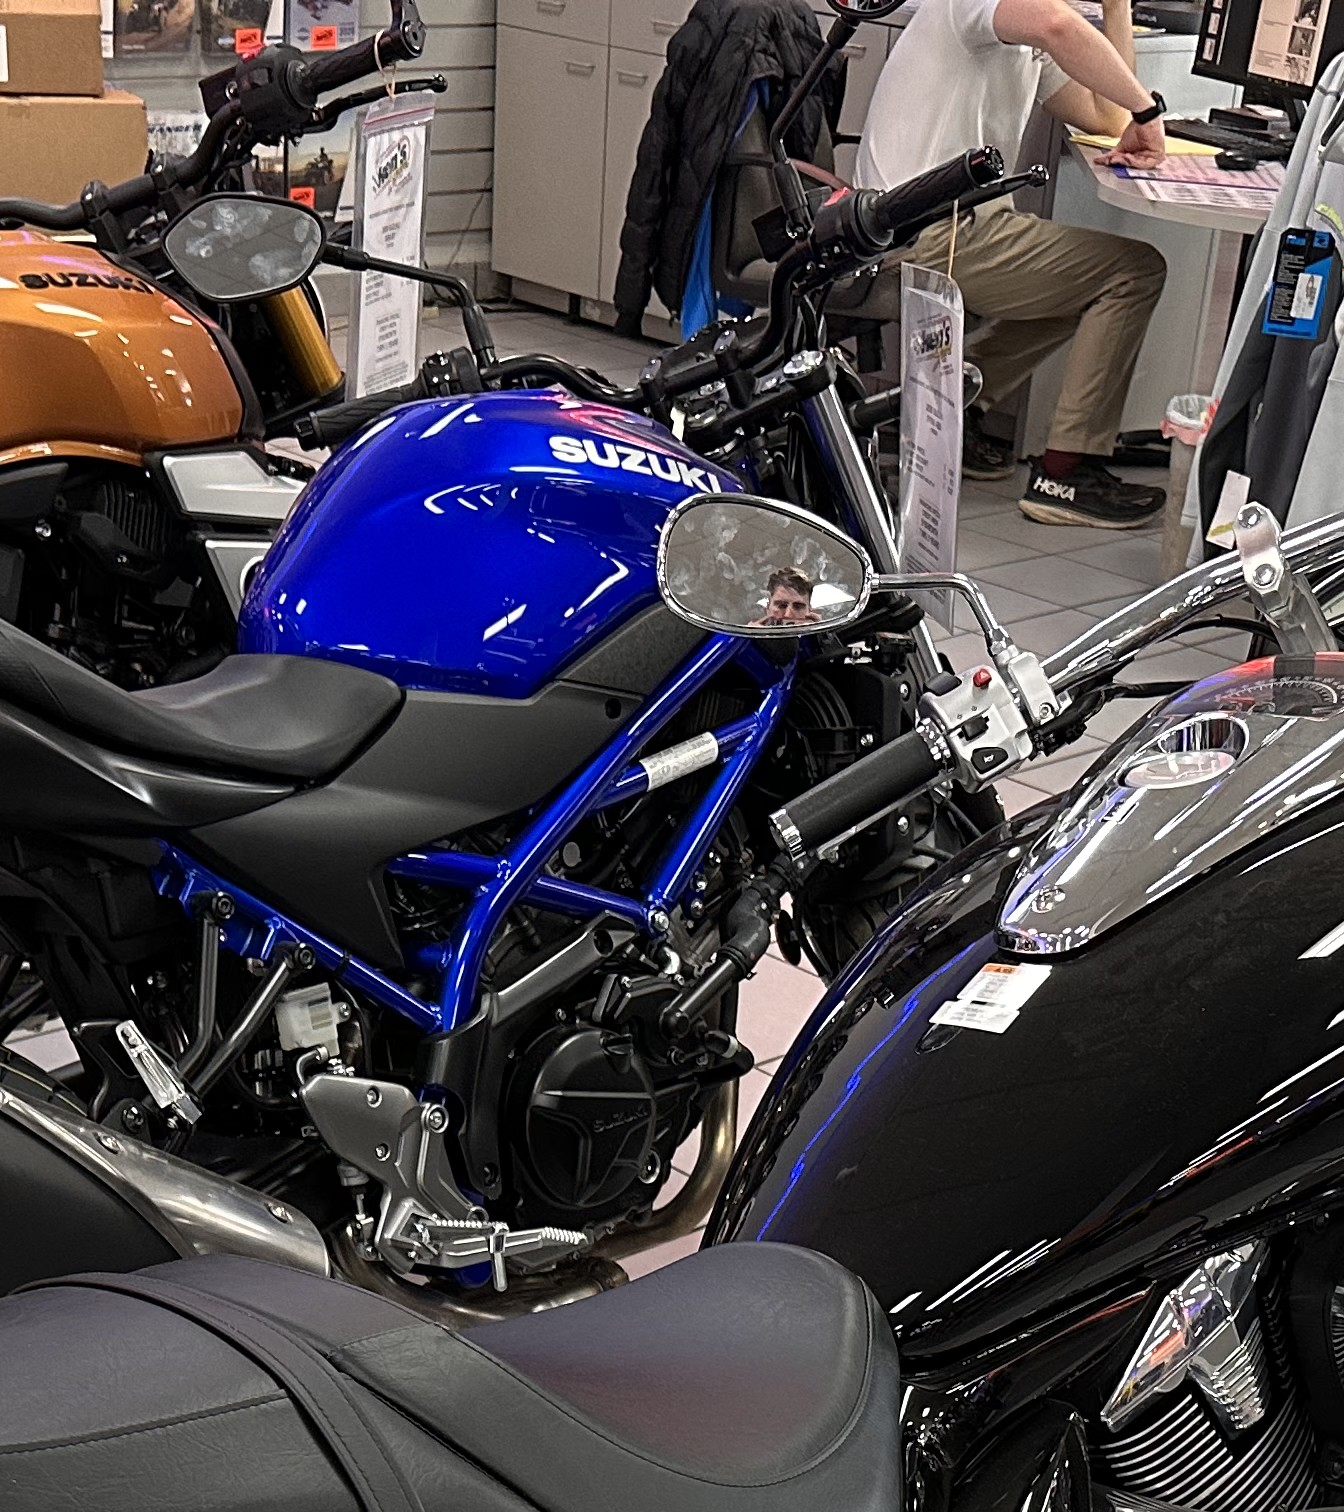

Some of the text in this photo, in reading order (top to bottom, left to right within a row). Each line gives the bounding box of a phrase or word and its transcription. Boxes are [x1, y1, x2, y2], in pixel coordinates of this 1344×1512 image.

[18, 271, 154, 296] SUZUKI
[548, 435, 722, 494] SUZUKI
[1033, 476, 1076, 502] HOKA
